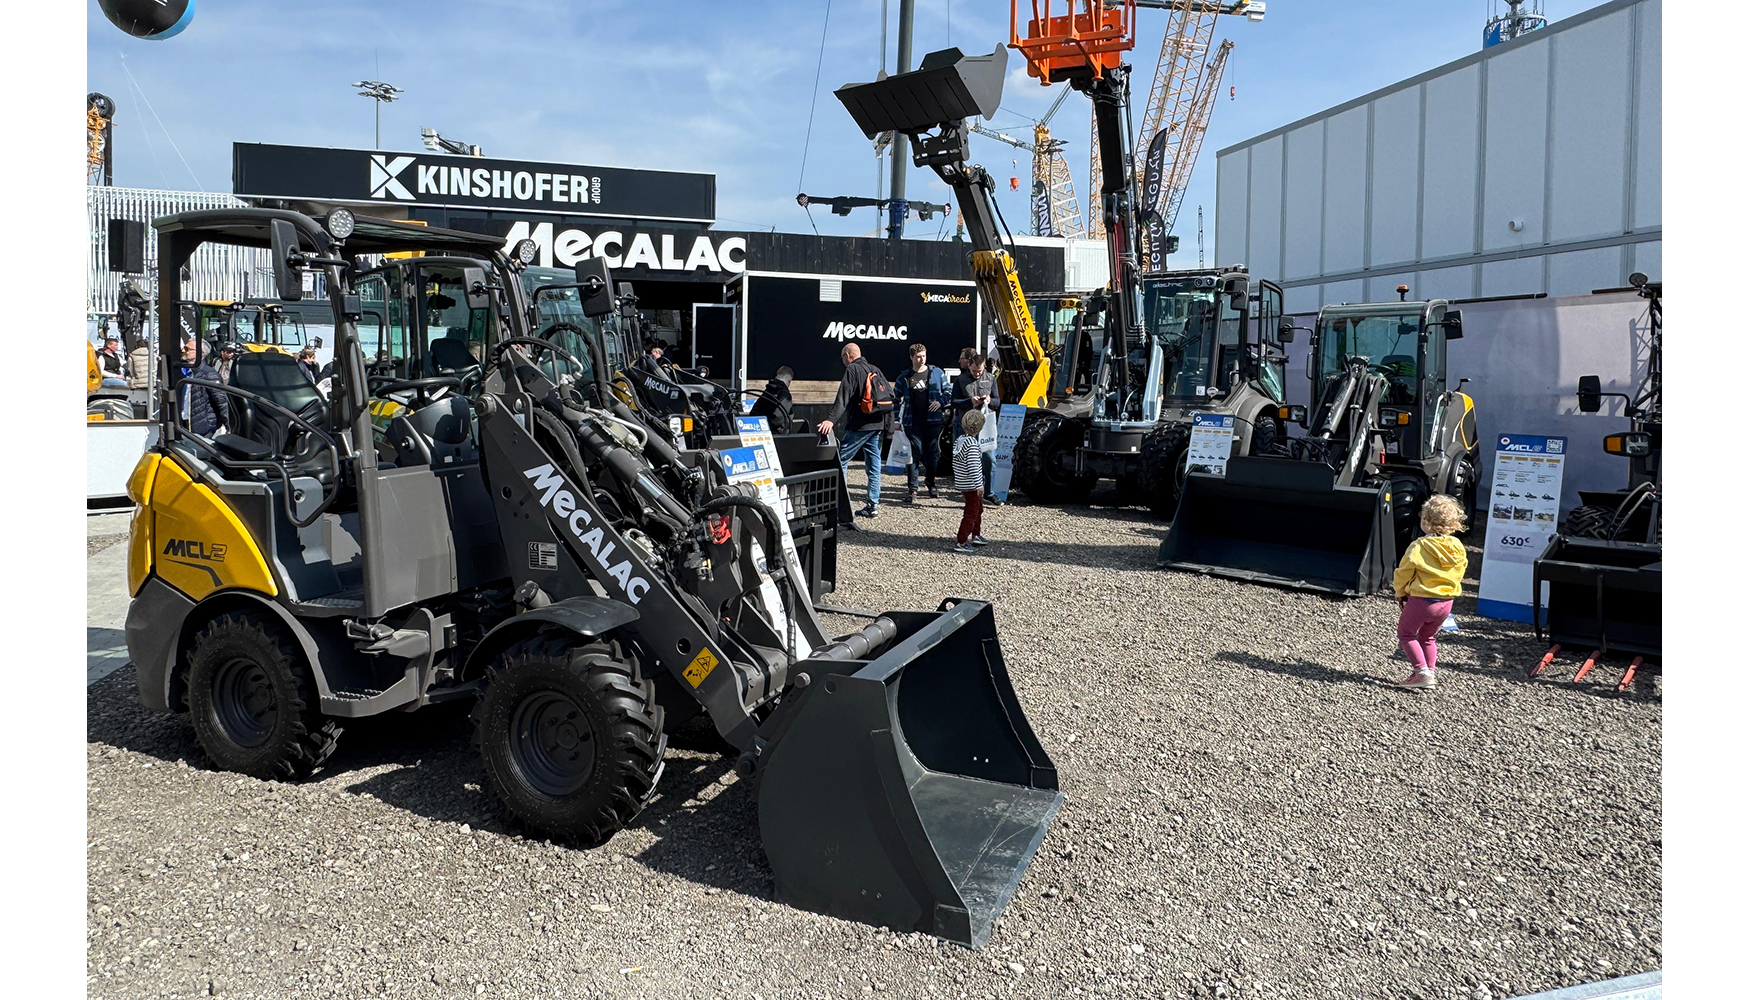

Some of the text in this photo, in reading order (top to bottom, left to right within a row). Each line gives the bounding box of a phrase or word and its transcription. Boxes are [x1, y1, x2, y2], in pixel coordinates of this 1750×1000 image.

[417, 164, 589, 204] KINSHOFER
[591, 176, 601, 205] GROUP
[163, 538, 228, 563] MCL2
